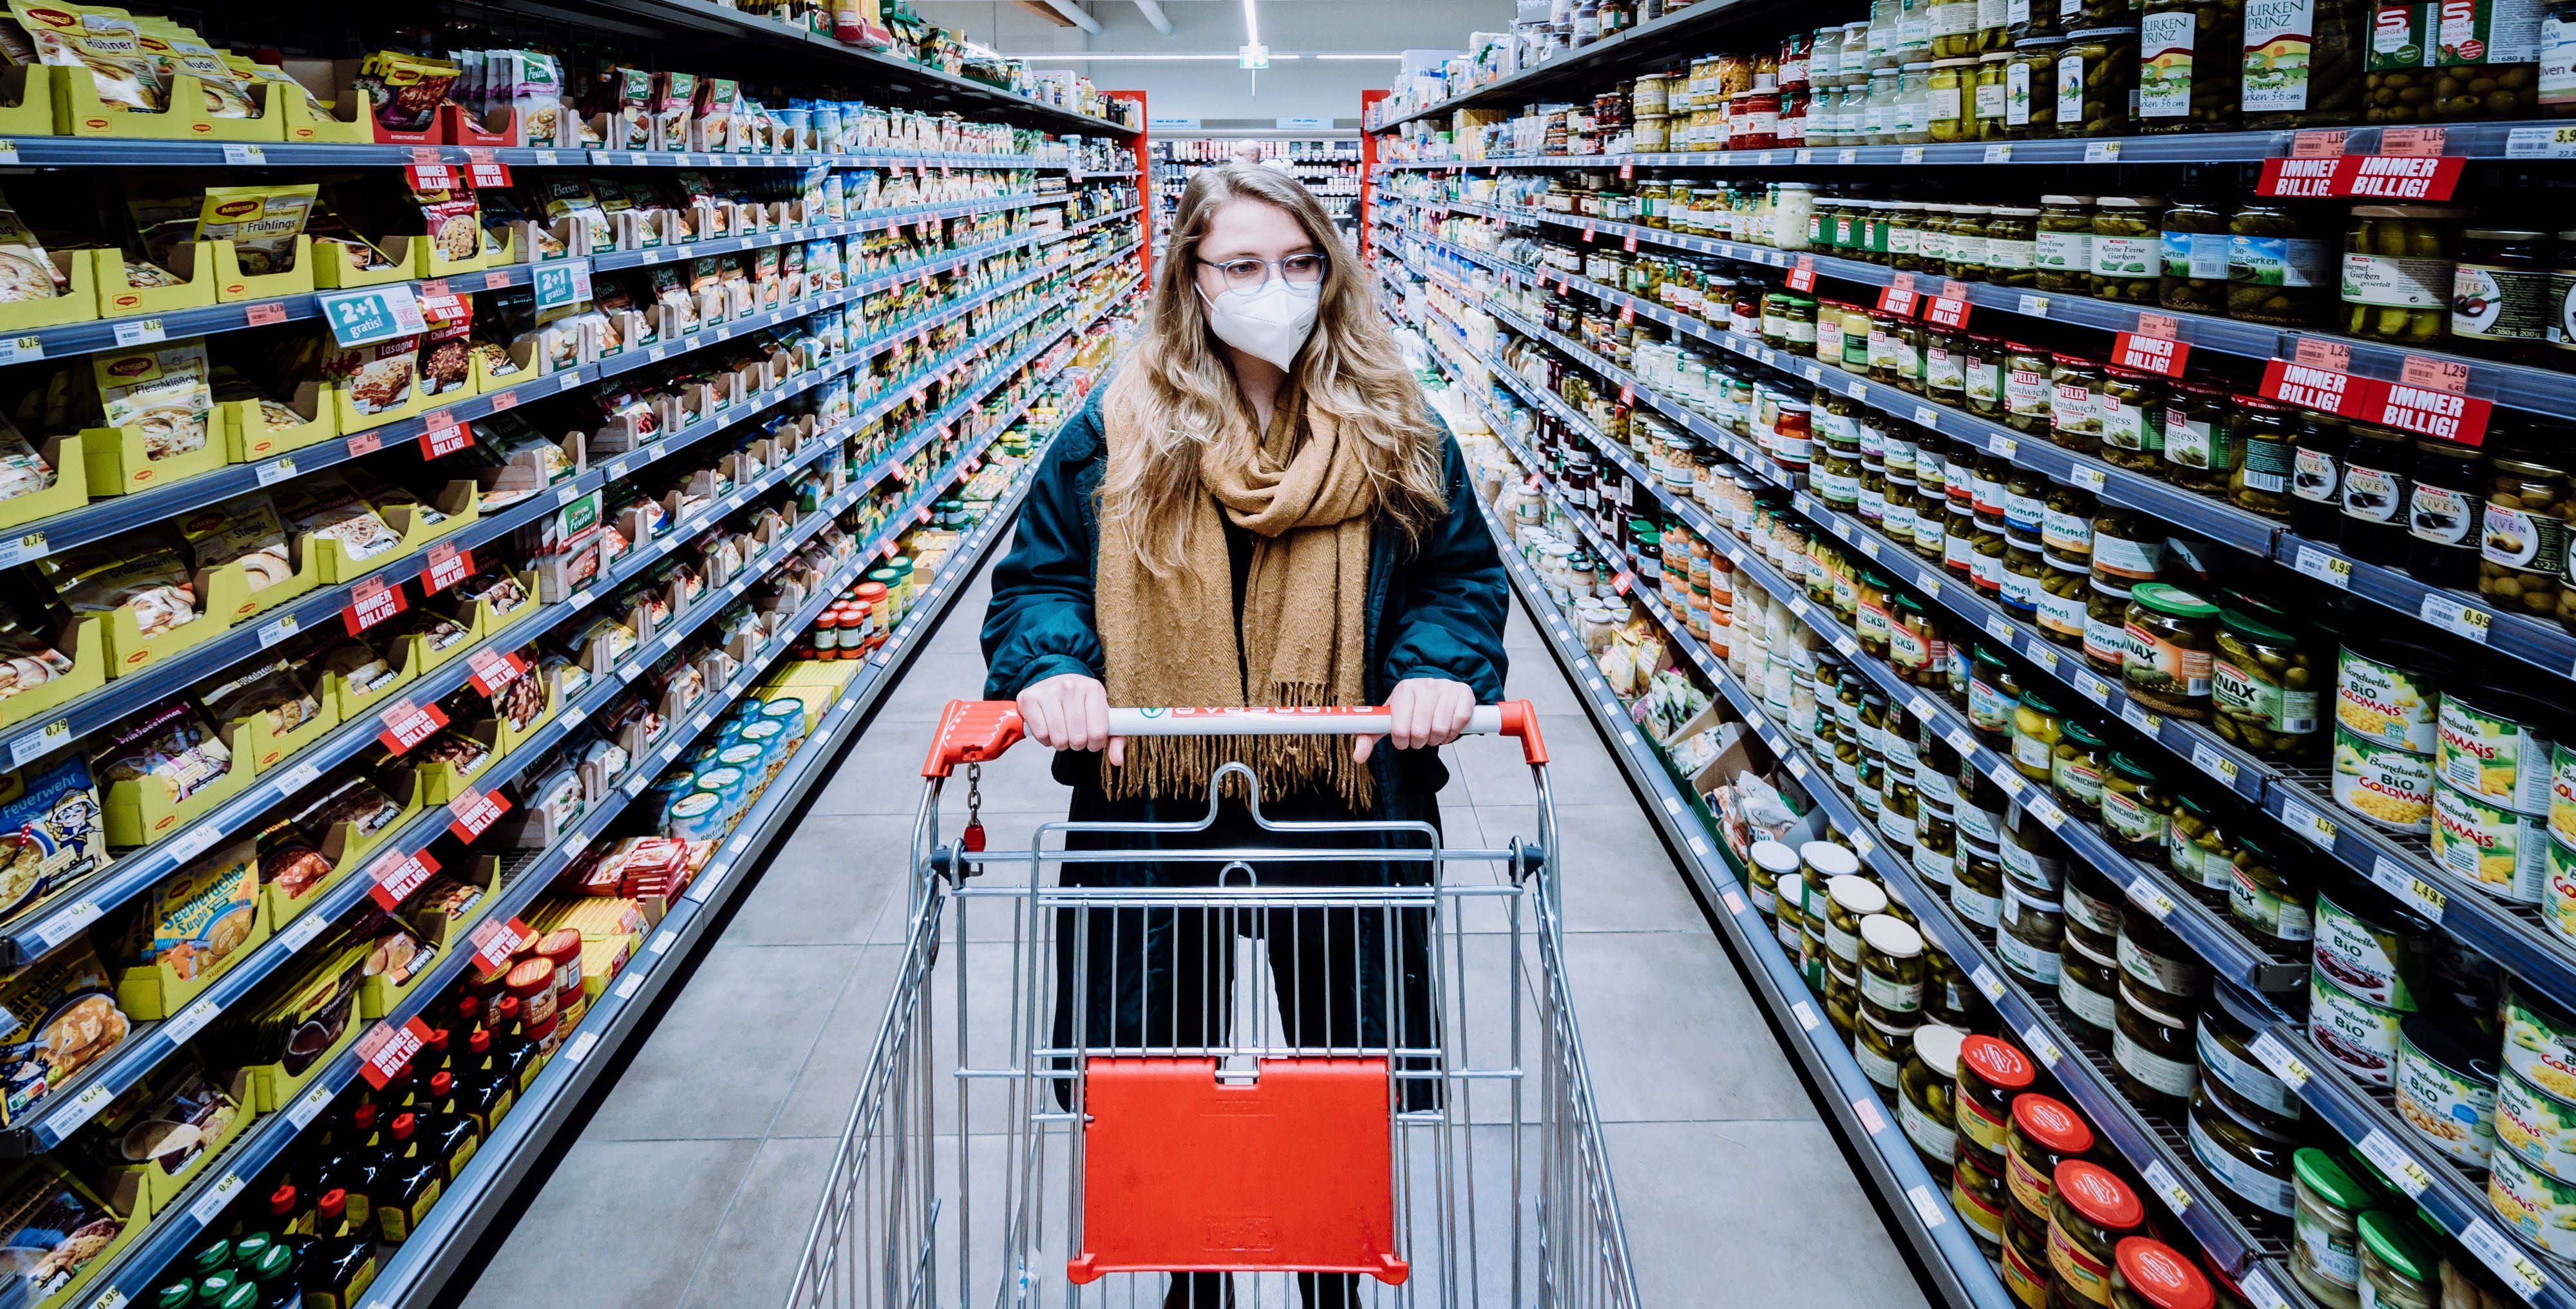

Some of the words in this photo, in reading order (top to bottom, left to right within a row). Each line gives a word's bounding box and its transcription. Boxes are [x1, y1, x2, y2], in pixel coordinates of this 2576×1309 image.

[2246, 1, 2304, 18] GURKEN
[2247, 14, 2291, 30] PRINZ
[2142, 30, 2177, 44] PRINZ
[2246, 28, 2292, 37] BURGENLAND
[2375, 28, 2407, 36] BUDGET
[84, 38, 133, 51] Hühner
[185, 59, 217, 70] Nudel
[627, 81, 648, 94] Basis
[673, 82, 691, 95] Basis
[715, 88, 732, 99] Basis
[2326, 132, 2345, 146] 1,19
[2421, 129, 2445, 143] 1,19
[2106, 142, 2119, 153] 4,99
[415, 165, 448, 177] IMMER
[472, 164, 500, 176] IMMER
[2358, 157, 2439, 178] IMMER
[419, 176, 451, 189] BILLIG!
[475, 175, 504, 187] BILLIG!
[2350, 176, 2431, 198] BILLIG!
[222, 203, 256, 213] Maggi
[247, 218, 296, 232] Frühlings
[2101, 245, 2123, 254] Kleine
[2108, 252, 2136, 261] Gurken
[2235, 247, 2247, 256] Bio-
[542, 269, 565, 290] 2+1
[1794, 269, 1811, 281] IMMER
[2350, 272, 2380, 280] Gurken
[545, 285, 566, 301] gratis!
[1791, 279, 1809, 291] BILLIG!
[1888, 288, 1913, 303] IMMER
[269, 303, 283, 314] 0,79
[339, 297, 380, 323] 2+1
[1884, 300, 1909, 315] BILLIG!
[1935, 298, 1962, 312] IMMER
[143, 320, 162, 331] 0,79
[1931, 310, 1959, 326] BILLIG!
[2163, 317, 2177, 328] 2,19
[349, 315, 383, 339] gratis!
[431, 331, 444, 341] Chili
[453, 325, 470, 335] Carne
[1820, 322, 1835, 332] FELIX
[18, 336, 39, 349] 0,79
[1870, 332, 1885, 341] FELIX
[381, 339, 413, 355] Lasagne
[1930, 348, 1947, 360] FELIX
[2128, 335, 2175, 357] IMMER
[2329, 344, 2350, 357] 1,29
[2125, 350, 2170, 373] BILLIG!
[2014, 373, 2039, 385] FELIX
[2442, 363, 2467, 378] 1,29
[2284, 364, 2347, 395] IMMER
[2447, 383, 2464, 391] 6.45
[2007, 384, 2048, 398] Sandwich
[2061, 387, 2086, 401] FELIX
[2277, 381, 2342, 412] BILLIG!
[2053, 398, 2097, 415] Sandwich
[2387, 385, 2465, 418] IMMER
[2382, 405, 2460, 439] BILLIG!
[428, 422, 461, 445] IMMER
[432, 436, 464, 456] BILLIG!
[279, 457, 294, 469] 0,79
[2092, 473, 2105, 483] 1,69
[2356, 469, 2380, 478] SPAR
[2347, 477, 2390, 493] OLIVEN
[2424, 487, 2448, 496] SPAR
[2414, 496, 2461, 513] OLIVEN
[2492, 507, 2514, 516] SPAR
[569, 511, 592, 532] Feine
[23, 532, 46, 547] 0,79
[430, 555, 462, 578] IMMER
[2329, 558, 2351, 576] 0,99
[434, 567, 467, 591] BILLIG!
[354, 590, 393, 615] IMMER
[281, 614, 296, 628] 0,79
[359, 603, 397, 630] BILLIG!
[2463, 609, 2490, 629] 0,99
[2045, 652, 2058, 664] 2,19
[477, 656, 509, 683] IMMER
[2344, 664, 2391, 690] Bonduelle
[484, 666, 518, 692] BILLIG!
[2213, 667, 2257, 703] KNAX
[2095, 682, 2109, 696] 2,19
[45, 719, 66, 737] 0,79
[390, 709, 429, 739] IMMER
[2146, 714, 2161, 728] 2,19
[399, 719, 439, 748] BILLIG!
[2219, 757, 2237, 775] 2,19
[2369, 755, 2429, 780] Bonduelle
[2, 773, 77, 819] Feuerwehr
[458, 796, 493, 827] IMMER
[2103, 798, 2146, 825] CORNICHONS
[467, 805, 502, 836] BILLIG!
[2316, 816, 2336, 836] 1,79
[381, 856, 421, 892] IMMER
[390, 865, 431, 902] BILLIG!
[2412, 878, 2436, 903] 1,49
[70, 896, 93, 916] 0,79
[178, 909, 209, 936] Suppe
[2327, 917, 2377, 950] Bonduelle
[480, 925, 513, 960] IMMER
[489, 934, 523, 968] BILLIG!
[207, 955, 236, 979] Suppen
[193, 997, 212, 1015] 0,79
[374, 1020, 388, 1037] 0,99
[371, 1026, 413, 1068] IMMER
[380, 1037, 424, 1078] BILLIG!
[2287, 1059, 2312, 1082] 1,79
[2404, 1055, 2454, 1097] Bonduelle
[80, 1082, 104, 1103] 0,79
[310, 1085, 327, 1104] 0,99
[218, 1172, 238, 1192] 0,99
[2402, 1163, 2431, 1187] 1,79
[2513, 1257, 2547, 1288] 1,29
